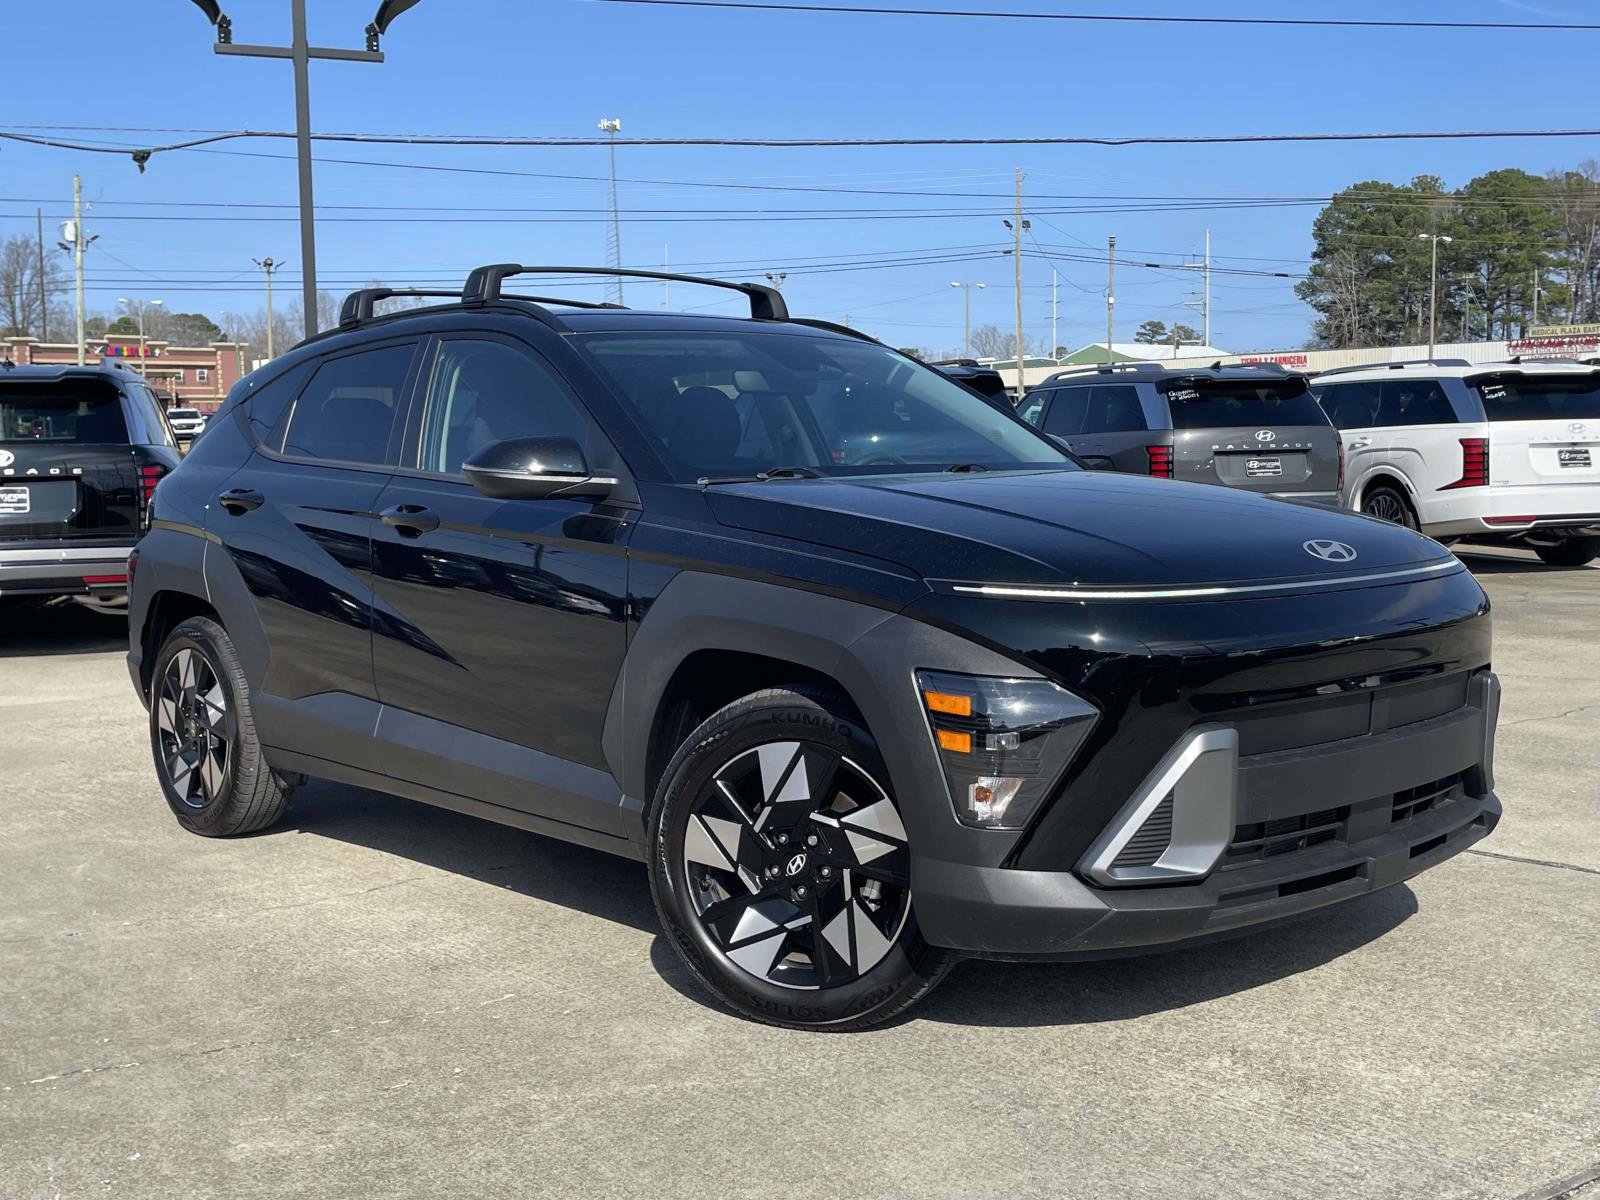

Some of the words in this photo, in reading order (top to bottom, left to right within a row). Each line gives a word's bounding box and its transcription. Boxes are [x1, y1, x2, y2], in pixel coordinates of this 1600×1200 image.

[1531, 328, 1559, 336] MEDICAL
[1560, 326, 1581, 334] PLAZA
[1583, 325, 1600, 333] EAST
[1211, 442, 1313, 450] PALISADE
[771, 711, 852, 737] KUMHO
